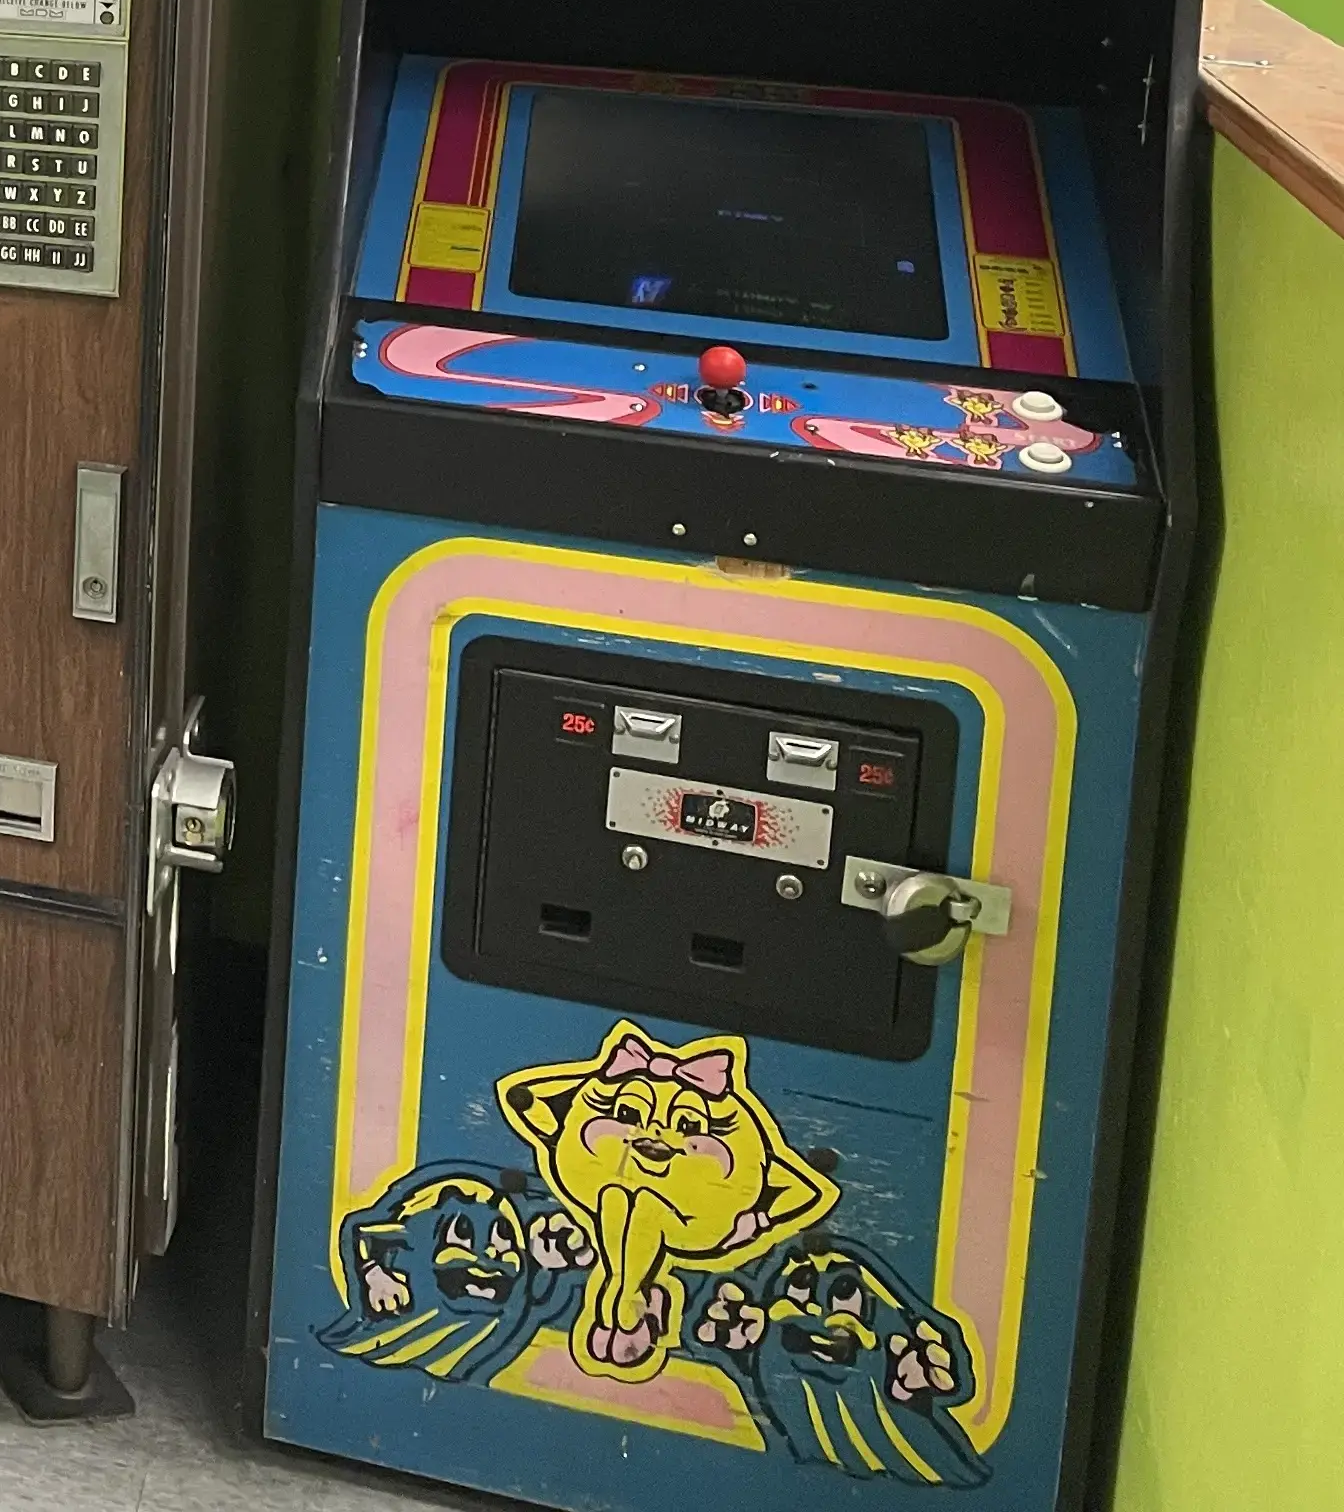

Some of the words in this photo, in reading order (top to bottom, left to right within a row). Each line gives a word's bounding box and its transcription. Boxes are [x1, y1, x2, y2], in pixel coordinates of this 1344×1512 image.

[62, 0, 87, 9] BELOW
[10, 63, 19, 76] B
[34, 64, 44, 79] C
[58, 66, 68, 81] D
[83, 67, 90, 81] E
[9, 94, 18, 108] G
[33, 96, 42, 110] H
[59, 98, 64, 111] I
[82, 99, 89, 112] J
[9, 125, 16, 138] L
[31, 126, 43, 140] M
[56, 129, 65, 143] N
[79, 130, 89, 144] O
[7, 155, 16, 168] R
[32, 158, 39, 172] S
[55, 160, 62, 172] T
[78, 161, 87, 175] U
[4, 186, 16, 200] W
[30, 188, 39, 201] X
[54, 189, 62, 202] Y
[77, 191, 86, 204] Z
[2, 216, 16, 230] BB
[26, 218, 40, 233] CC
[49, 219, 65, 234] DD
[75, 222, 88, 236] EE
[0, 247, 16, 260] GG
[24, 248, 41, 262] HH
[52, 252, 61, 264] II
[74, 252, 86, 267] JJ
[561, 712, 596, 735] 25¢
[685, 813, 751, 835] MIDWAY
